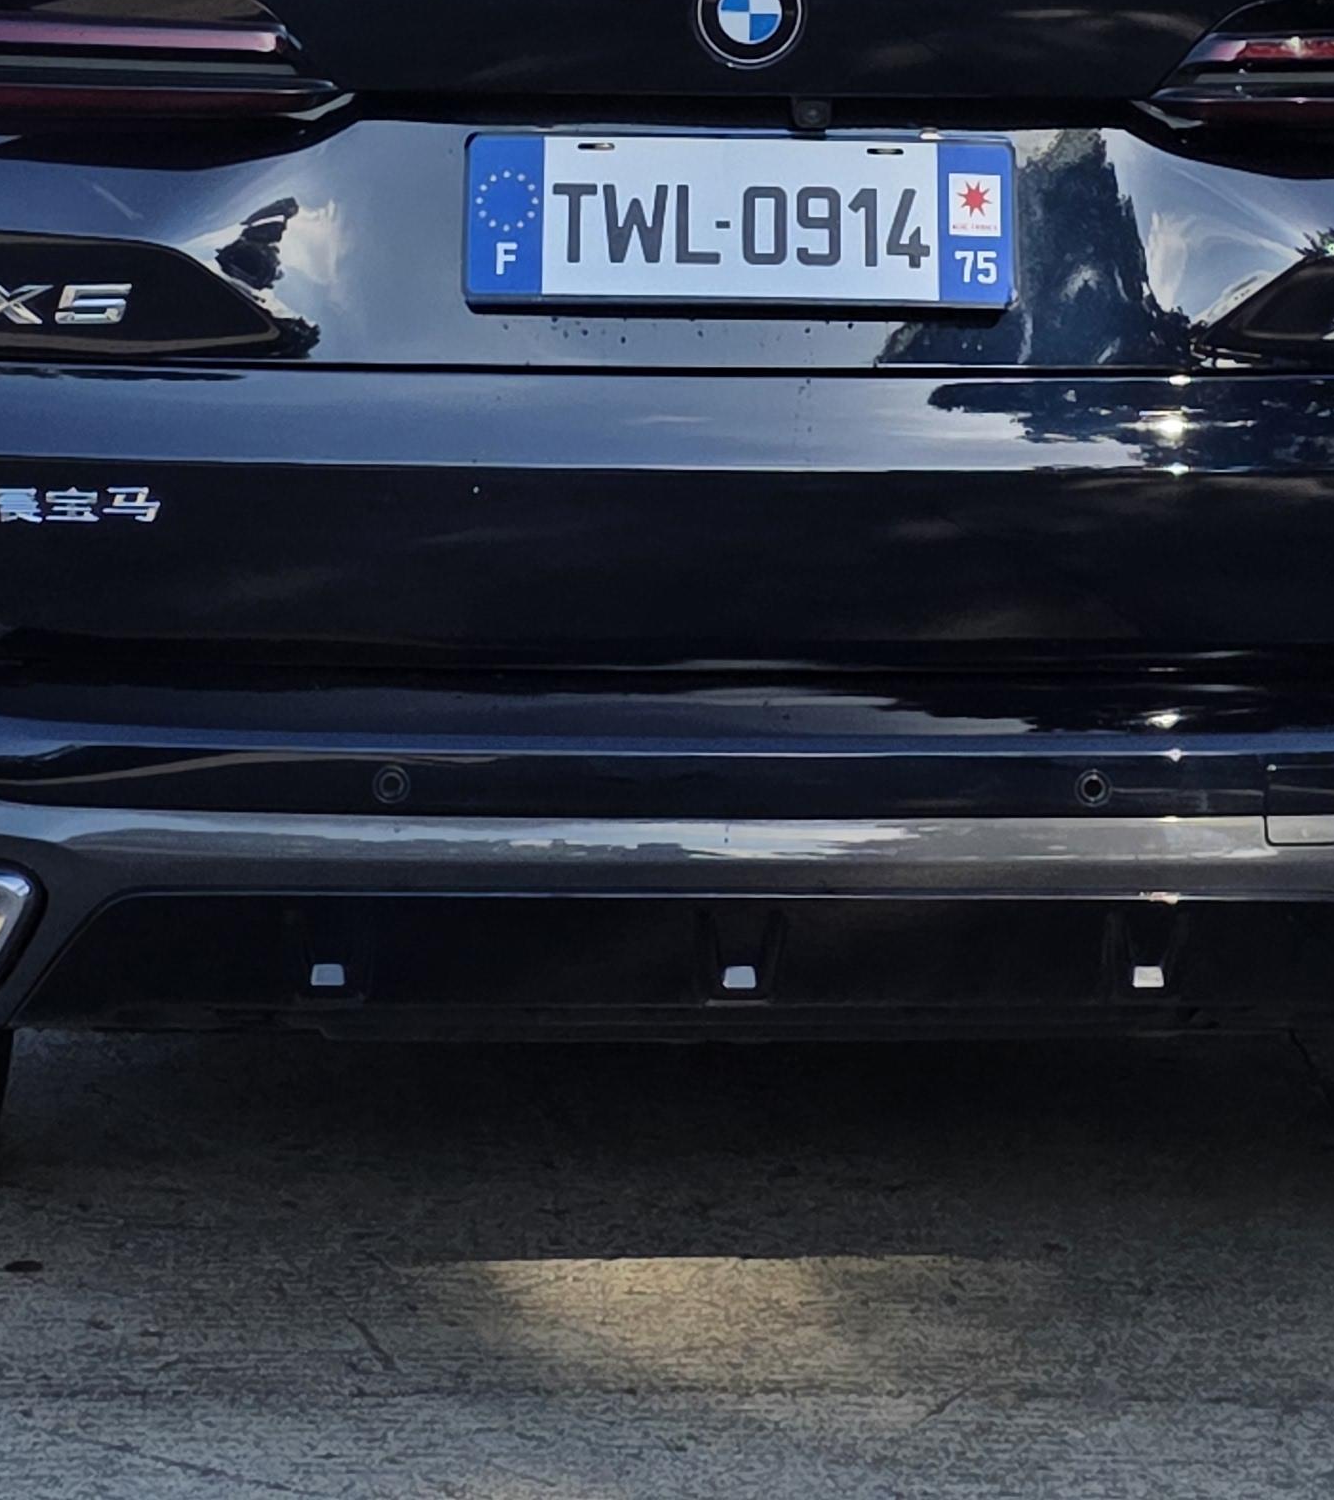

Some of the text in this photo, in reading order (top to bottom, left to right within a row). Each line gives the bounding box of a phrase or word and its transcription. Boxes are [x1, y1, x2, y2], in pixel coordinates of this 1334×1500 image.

[552, 183, 931, 269] TWL-0914
[495, 243, 518, 275] F
[954, 250, 998, 285] 75
